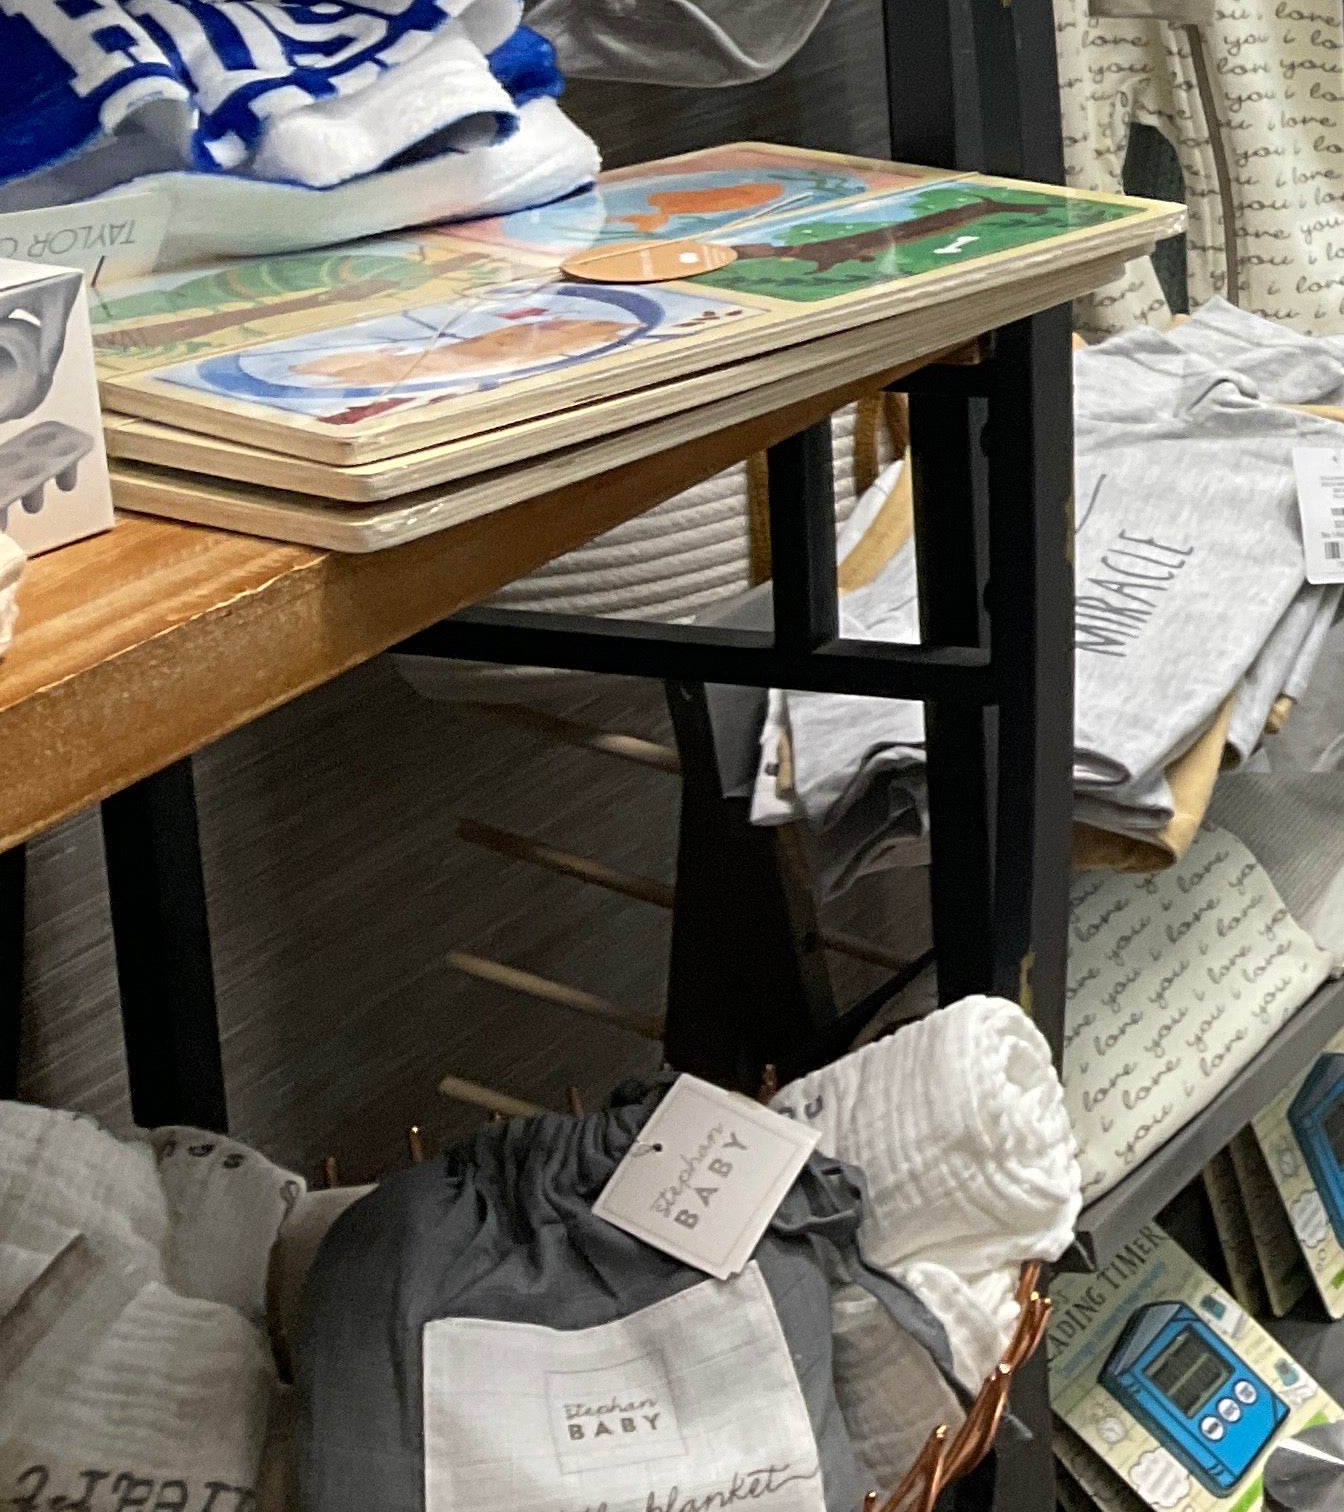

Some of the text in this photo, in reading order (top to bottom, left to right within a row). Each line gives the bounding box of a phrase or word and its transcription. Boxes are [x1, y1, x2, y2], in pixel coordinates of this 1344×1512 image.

[26, 217, 136, 254] TAYLOR
[1235, 226, 1291, 239] ove
[1074, 529, 1194, 658] MIRACLE
[1228, 863, 1257, 895] yo
[1258, 908, 1288, 941] yo
[1066, 967, 1102, 1001] ove
[674, 1130, 749, 1230] BABY
[1047, 1225, 1168, 1372] ADING TIMER
[567, 1413, 662, 1441] BABY
[645, 1463, 820, 1512] blanket
